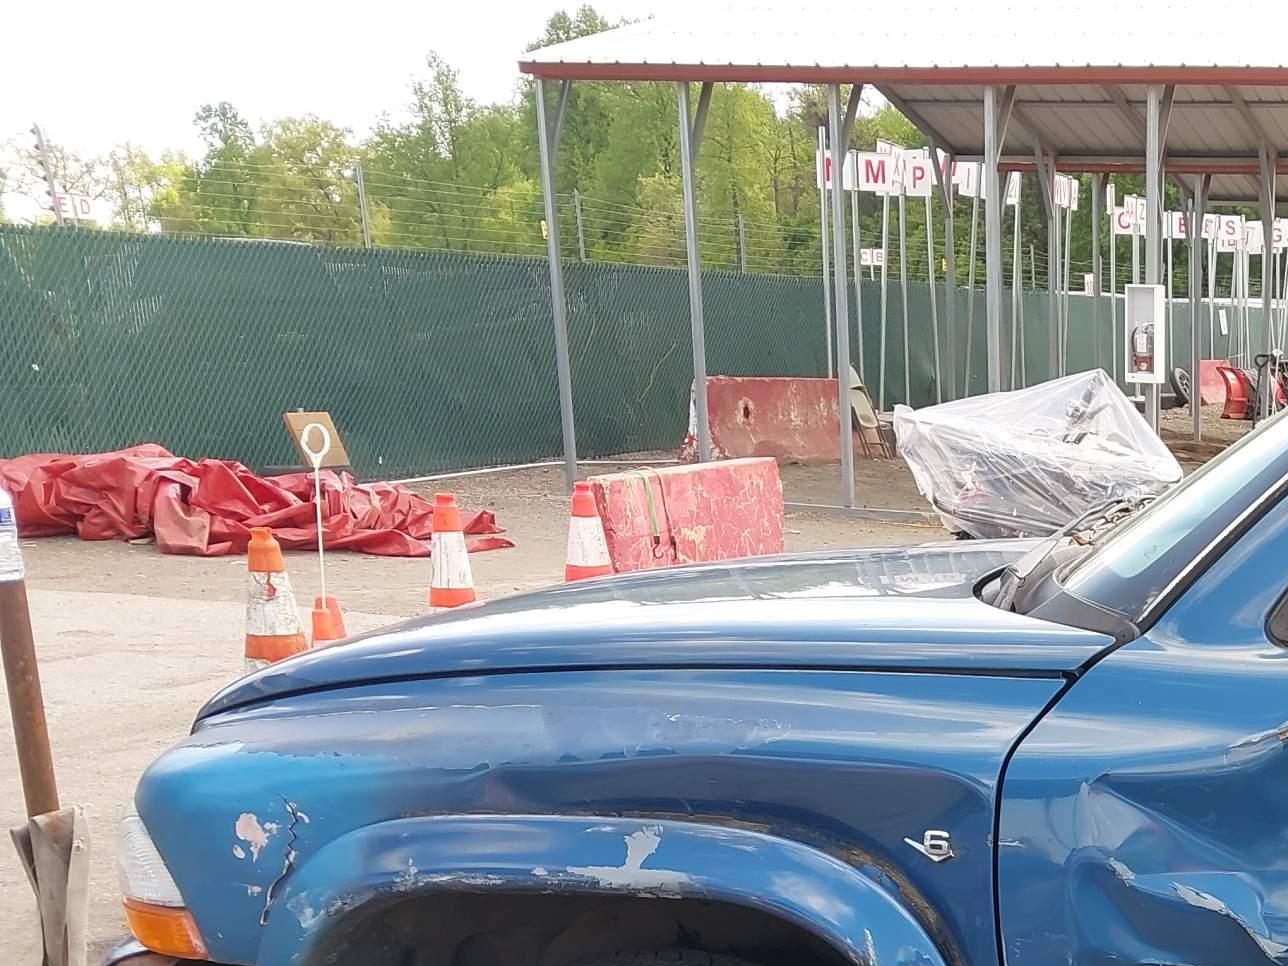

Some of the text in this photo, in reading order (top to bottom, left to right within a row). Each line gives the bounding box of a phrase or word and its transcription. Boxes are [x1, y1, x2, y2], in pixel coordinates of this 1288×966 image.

[864, 159, 886, 184] M
[912, 165, 925, 189] P
[1226, 220, 1236, 236] S
[1272, 228, 1282, 243] G
